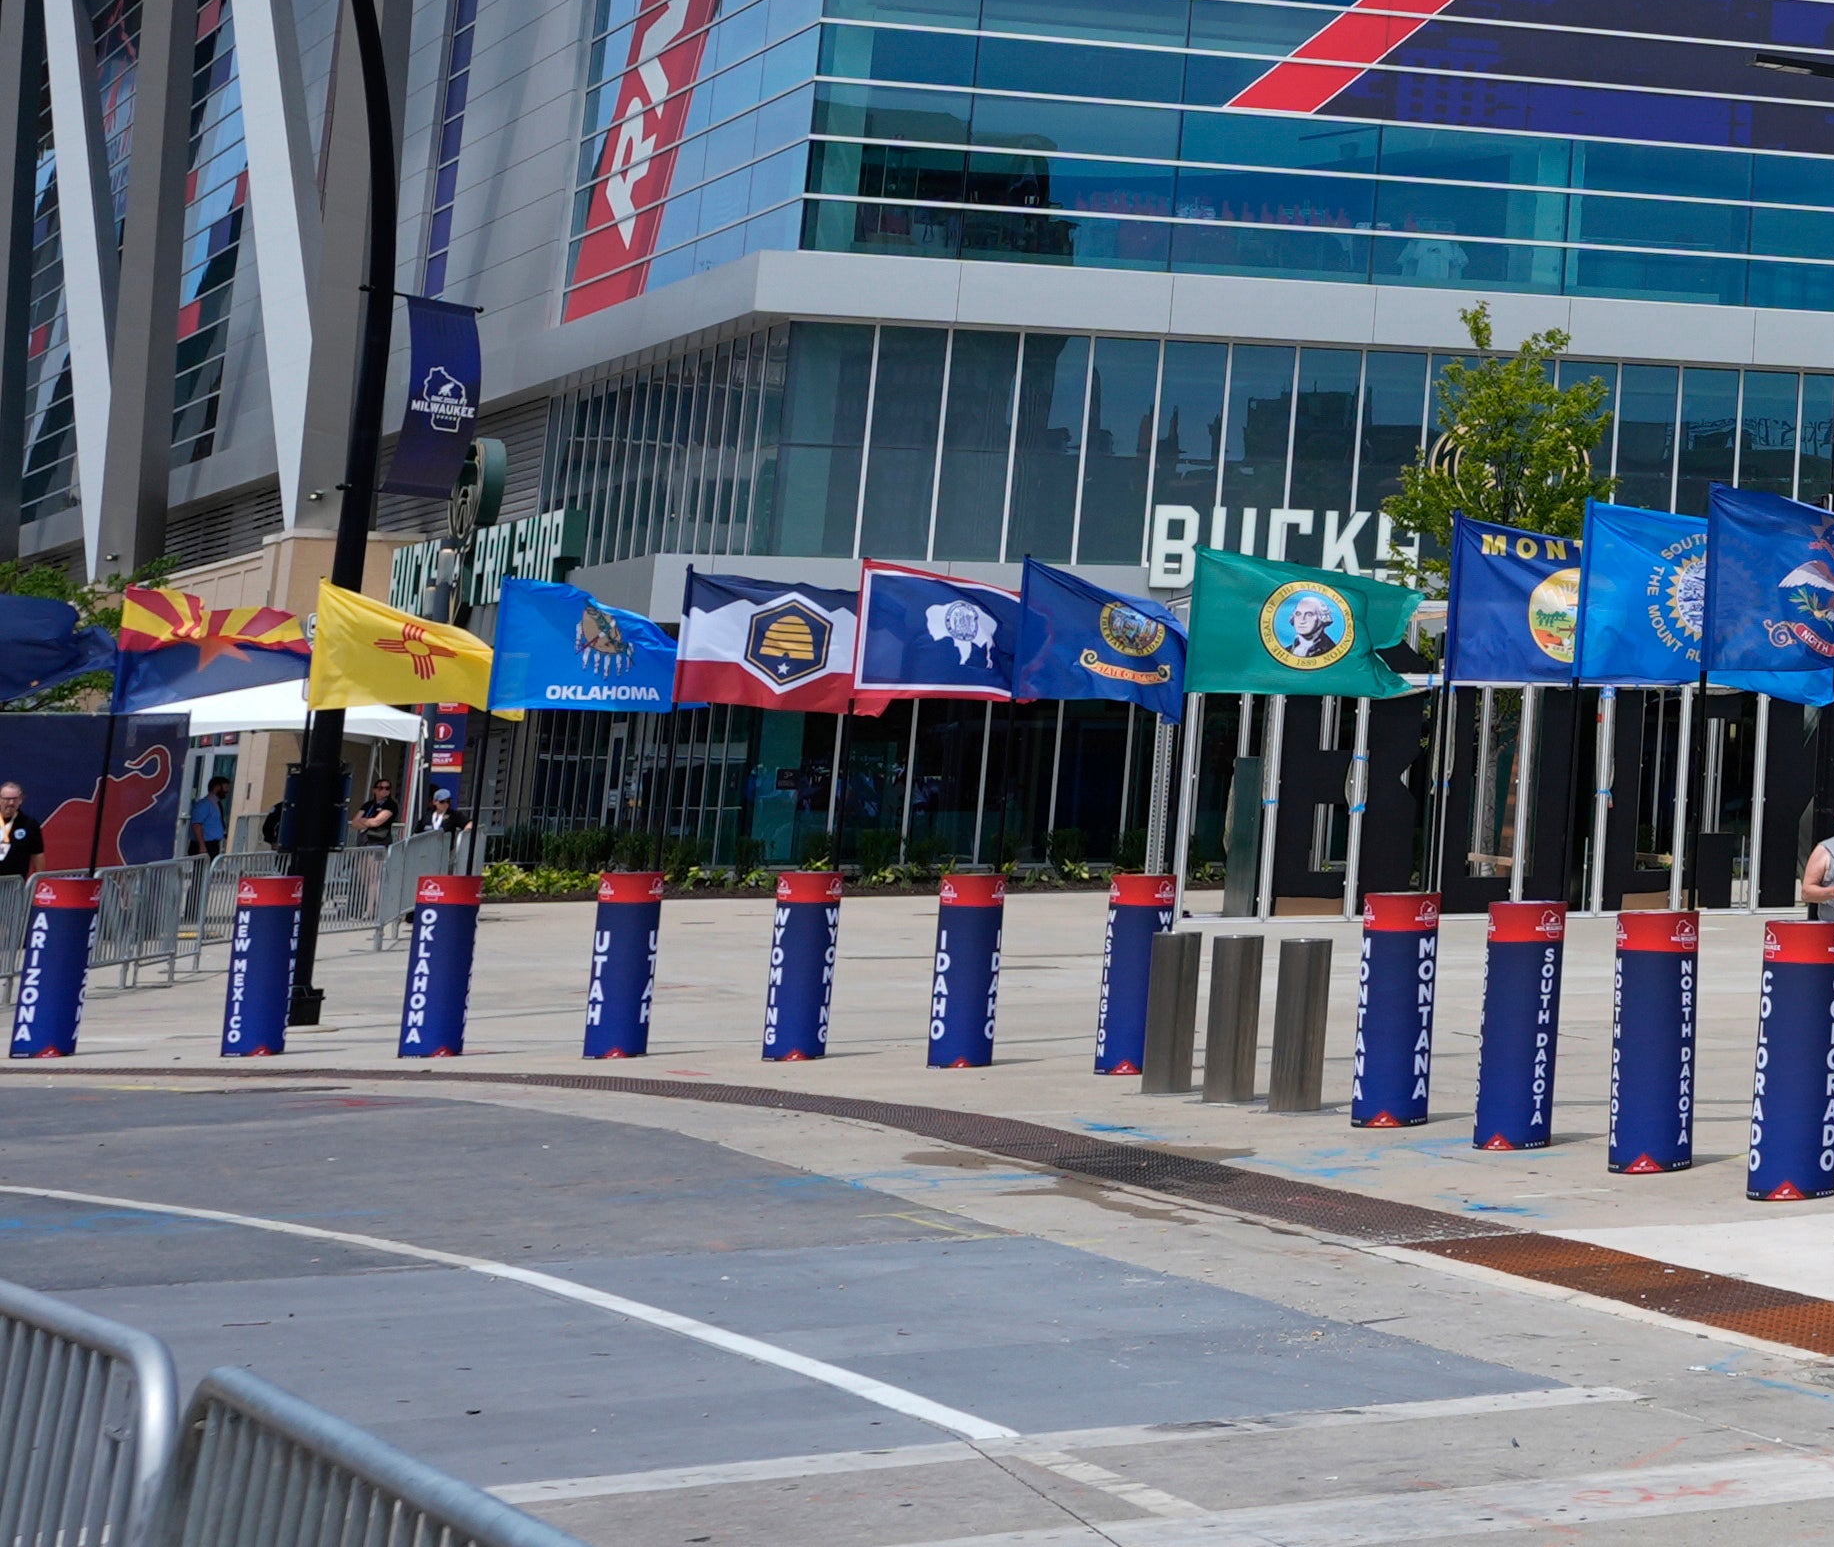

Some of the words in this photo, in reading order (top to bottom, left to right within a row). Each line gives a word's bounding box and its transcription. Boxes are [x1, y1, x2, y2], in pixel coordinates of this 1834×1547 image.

[411, 399, 475, 418] MILWAUKEE
[470, 523, 512, 606] PRO
[511, 507, 564, 583] SHOP
[1646, 565, 1666, 597] THE
[1646, 604, 1684, 653] MOUNT
[545, 684, 660, 701] OKLAHOMA
[14, 912, 49, 1042] ARIZONA
[234, 911, 251, 952] NEW
[405, 908, 438, 1044] OKLAHOMA
[586, 930, 611, 1026] UTAH
[764, 907, 791, 1046] WYOMING
[817, 907, 840, 1044] WYOMING
[227, 959, 248, 1044] MEXICO
[930, 930, 951, 1041] IDAHO
[1096, 909, 1117, 1058] WASHINGTON
[1352, 936, 1371, 1102] MONTANA
[1411, 936, 1436, 1101] MONTANA
[1537, 947, 1555, 1025] SOUTH
[1680, 959, 1693, 1039] NORTH
[1529, 1032, 1549, 1126] DAKOTA
[1676, 1047, 1692, 1146] DAKOTA
[1748, 970, 1773, 1172] COLORADO
